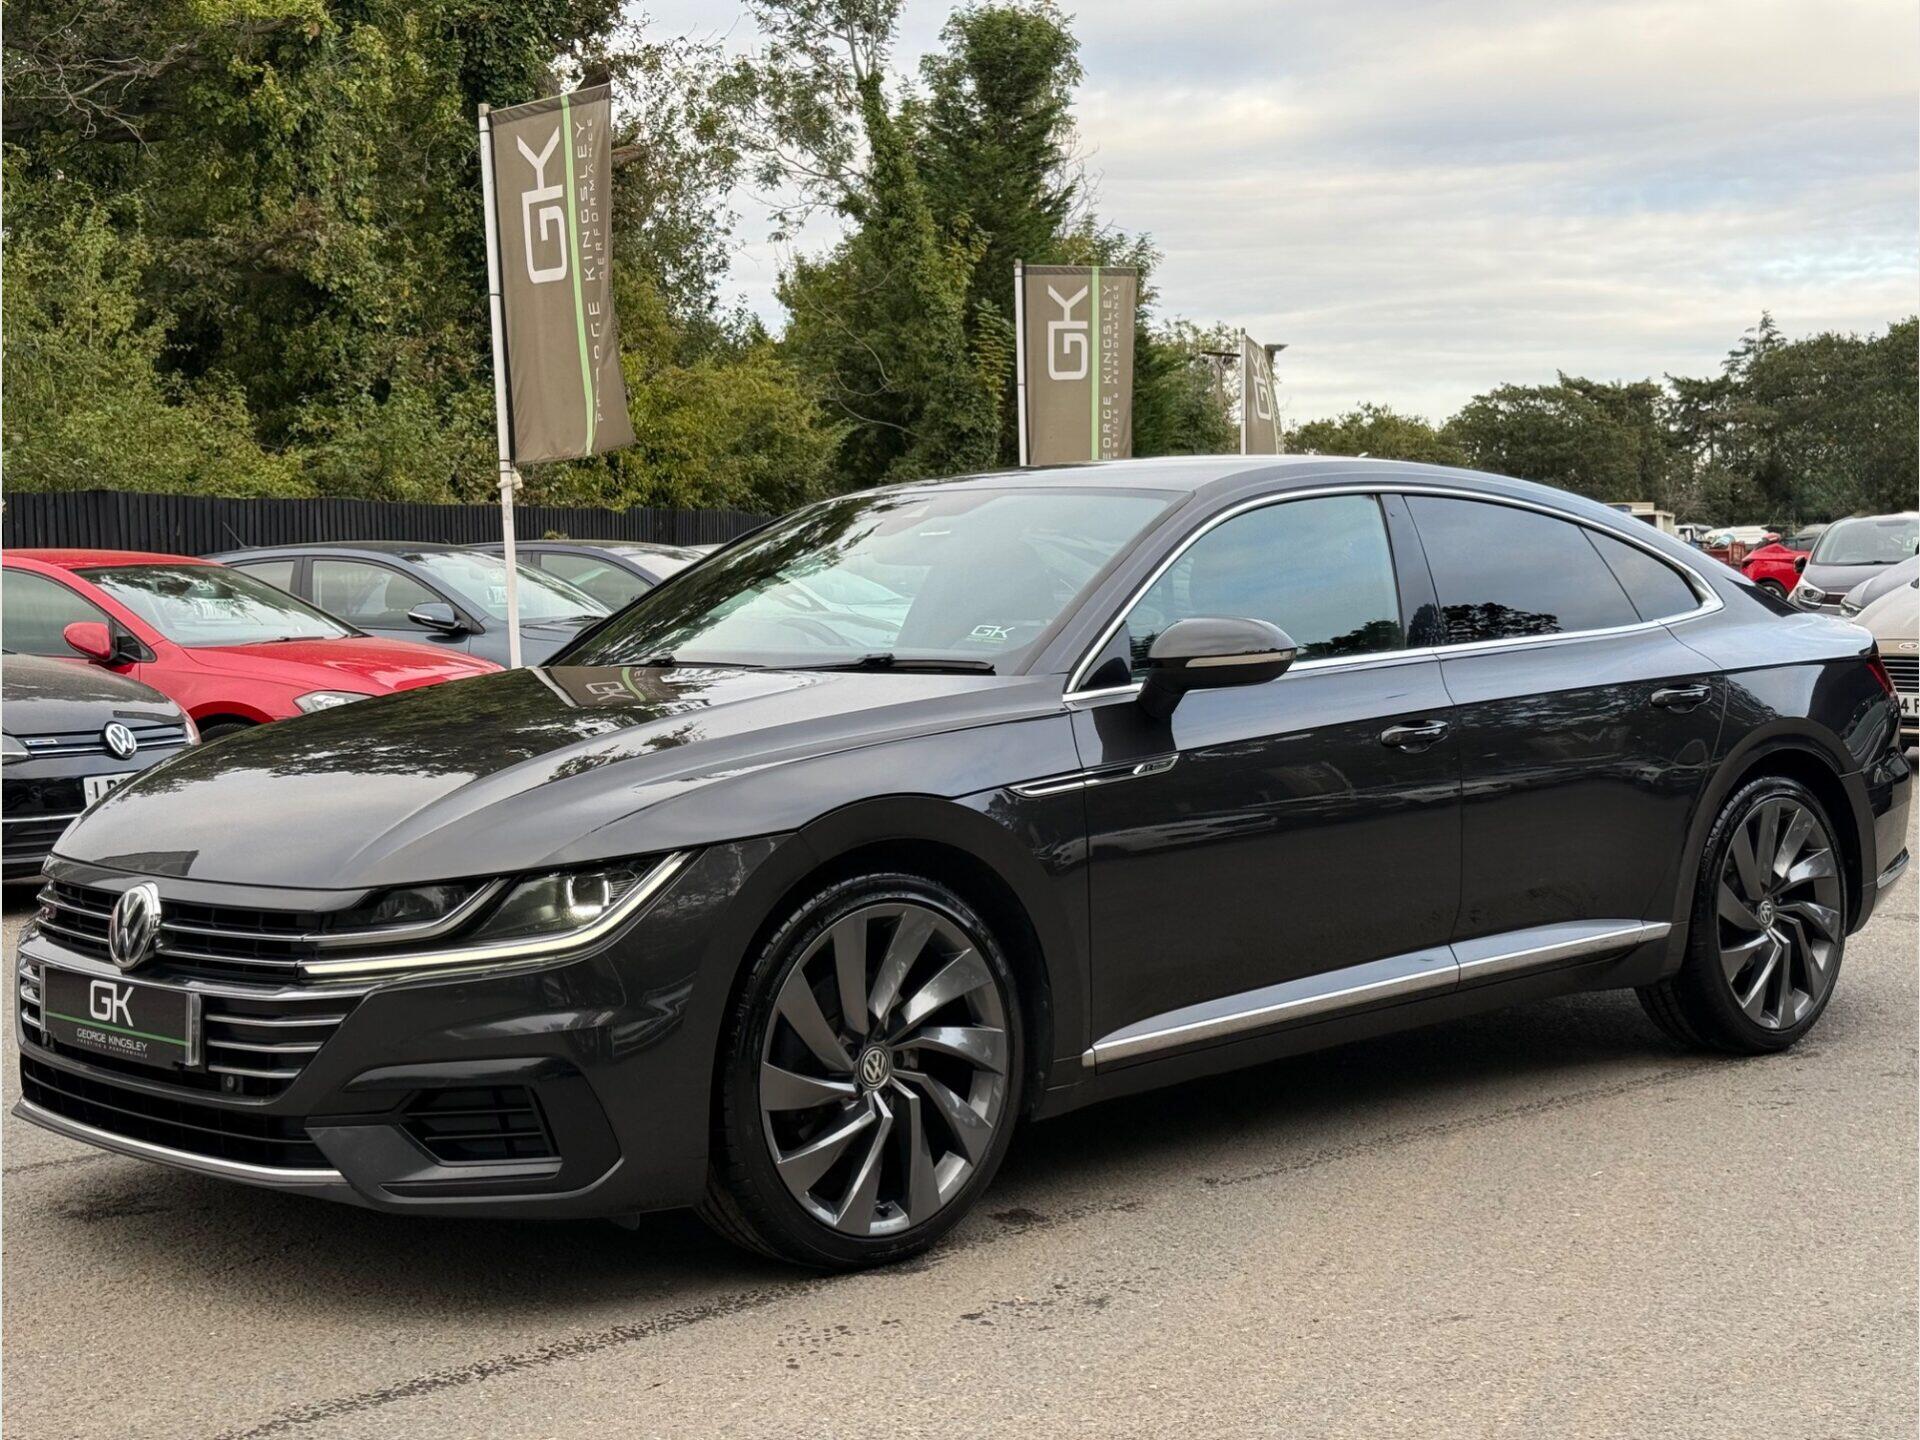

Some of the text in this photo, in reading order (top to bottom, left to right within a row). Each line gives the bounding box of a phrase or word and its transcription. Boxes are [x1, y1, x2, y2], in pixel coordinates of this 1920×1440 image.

[516, 125, 568, 285] GK
[576, 121, 596, 282] KINGSLEY
[1047, 284, 1089, 381] GK
[1102, 284, 1112, 384] KINGSLEY
[970, 624, 1015, 639] GK
[76, 1027, 107, 1044] GEORGE
[108, 1035, 148, 1053] KINGSLEY
[89, 979, 135, 1027] GK
